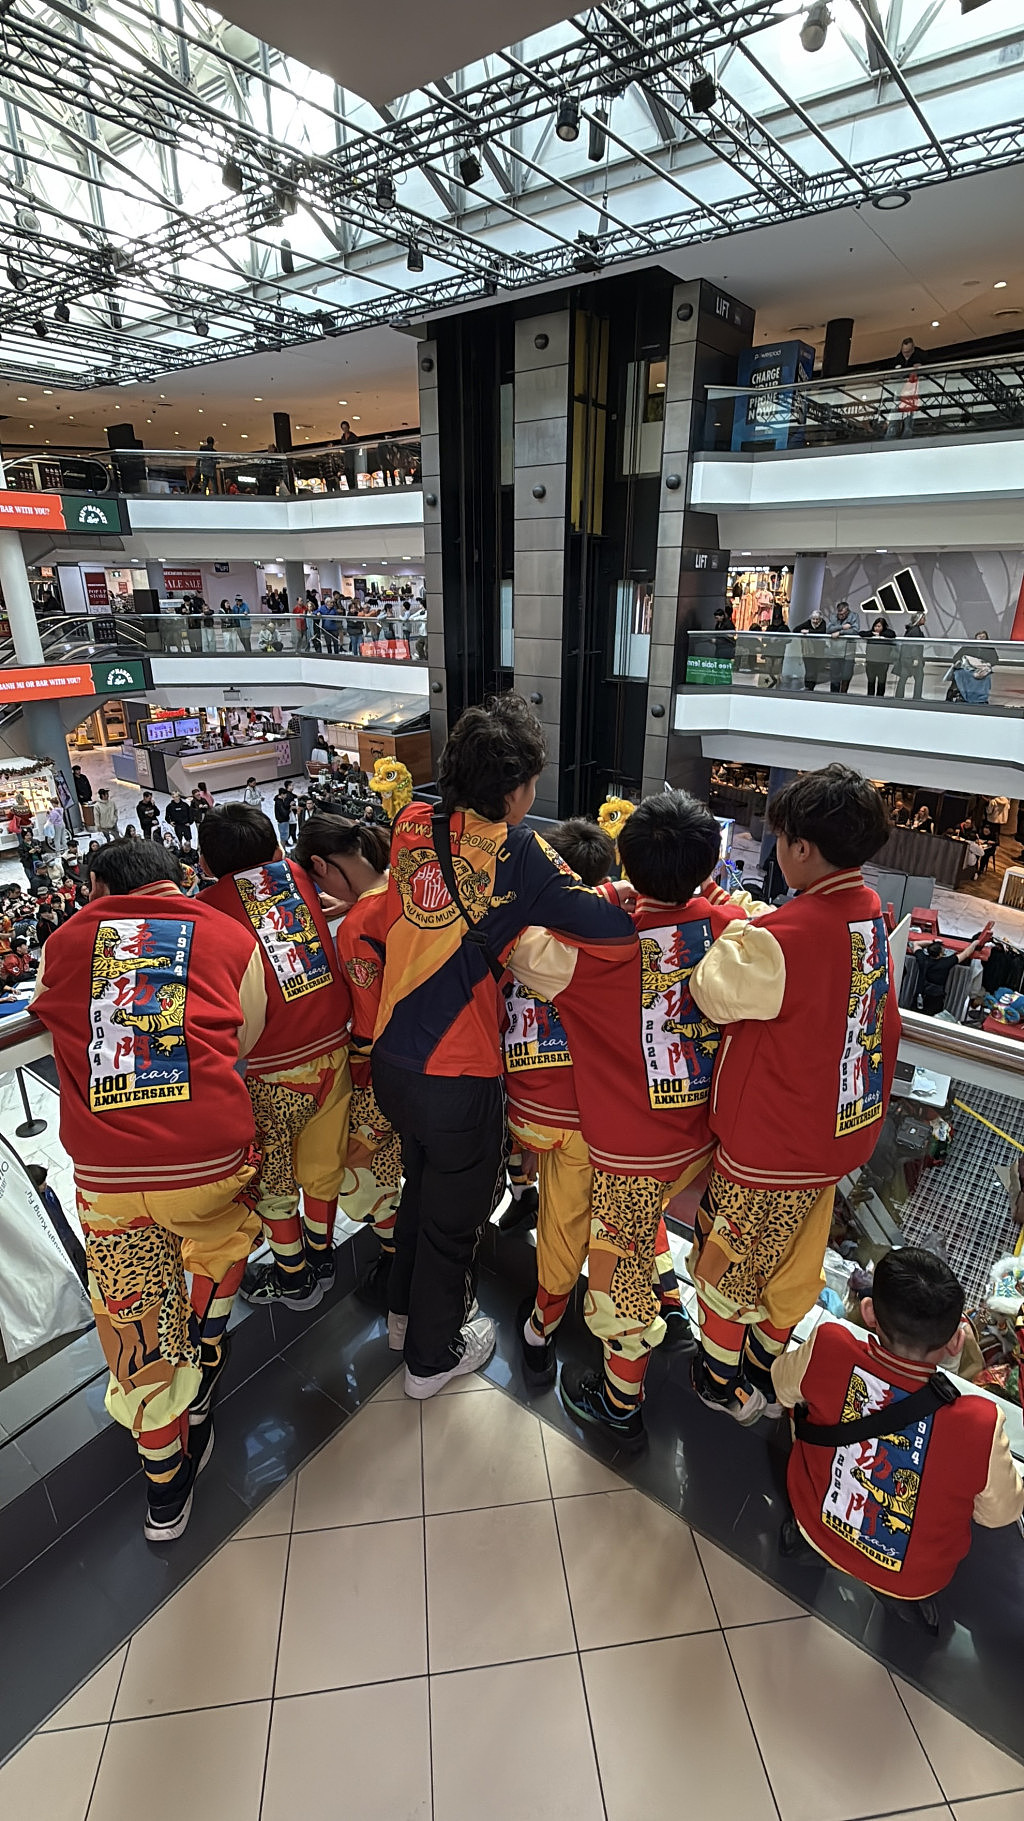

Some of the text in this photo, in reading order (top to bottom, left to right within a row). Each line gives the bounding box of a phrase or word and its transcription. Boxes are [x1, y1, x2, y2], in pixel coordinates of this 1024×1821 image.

[716, 296, 730, 319] LIFT
[752, 367, 780, 384] CHARGE
[750, 392, 778, 408] PHONE
[748, 406, 776, 420] NOW!
[14, 506, 34, 514] WITH
[34, 507, 50, 516] YOU?
[695, 554, 708, 568] LIFT
[184, 580, 202, 588] SALE
[282, 863, 300, 900] 1924
[406, 900, 456, 924] YAU KNG MUN
[702, 924, 710, 952] 19
[173, 924, 187, 977] 1924
[263, 936, 284, 972] 2024
[282, 974, 304, 991] 100
[287, 974, 331, 997] ANNIVERSARY
[113, 923, 157, 1070] 柔功門
[507, 1002, 517, 1033] 025
[93, 1010, 104, 1066] 2024
[508, 1039, 568, 1058] 101 ear
[645, 1020, 658, 1070] 2024
[510, 1053, 571, 1068] ANNIVERSAR
[94, 1074, 128, 1095] 100
[652, 1078, 683, 1093] 100
[94, 1086, 184, 1107] ANNIVERSARY
[655, 1090, 710, 1104] ANNIVERS
[839, 1104, 880, 1131] ANNIVERSARY
[840, 1100, 856, 1120] 101
[34, 1204, 47, 1230] Kung
[911, 1418, 928, 1465] 924
[830, 1454, 844, 1504] 2024
[826, 1510, 899, 1556] 100 ears
[826, 1520, 897, 1567] ANNIVERSARY
